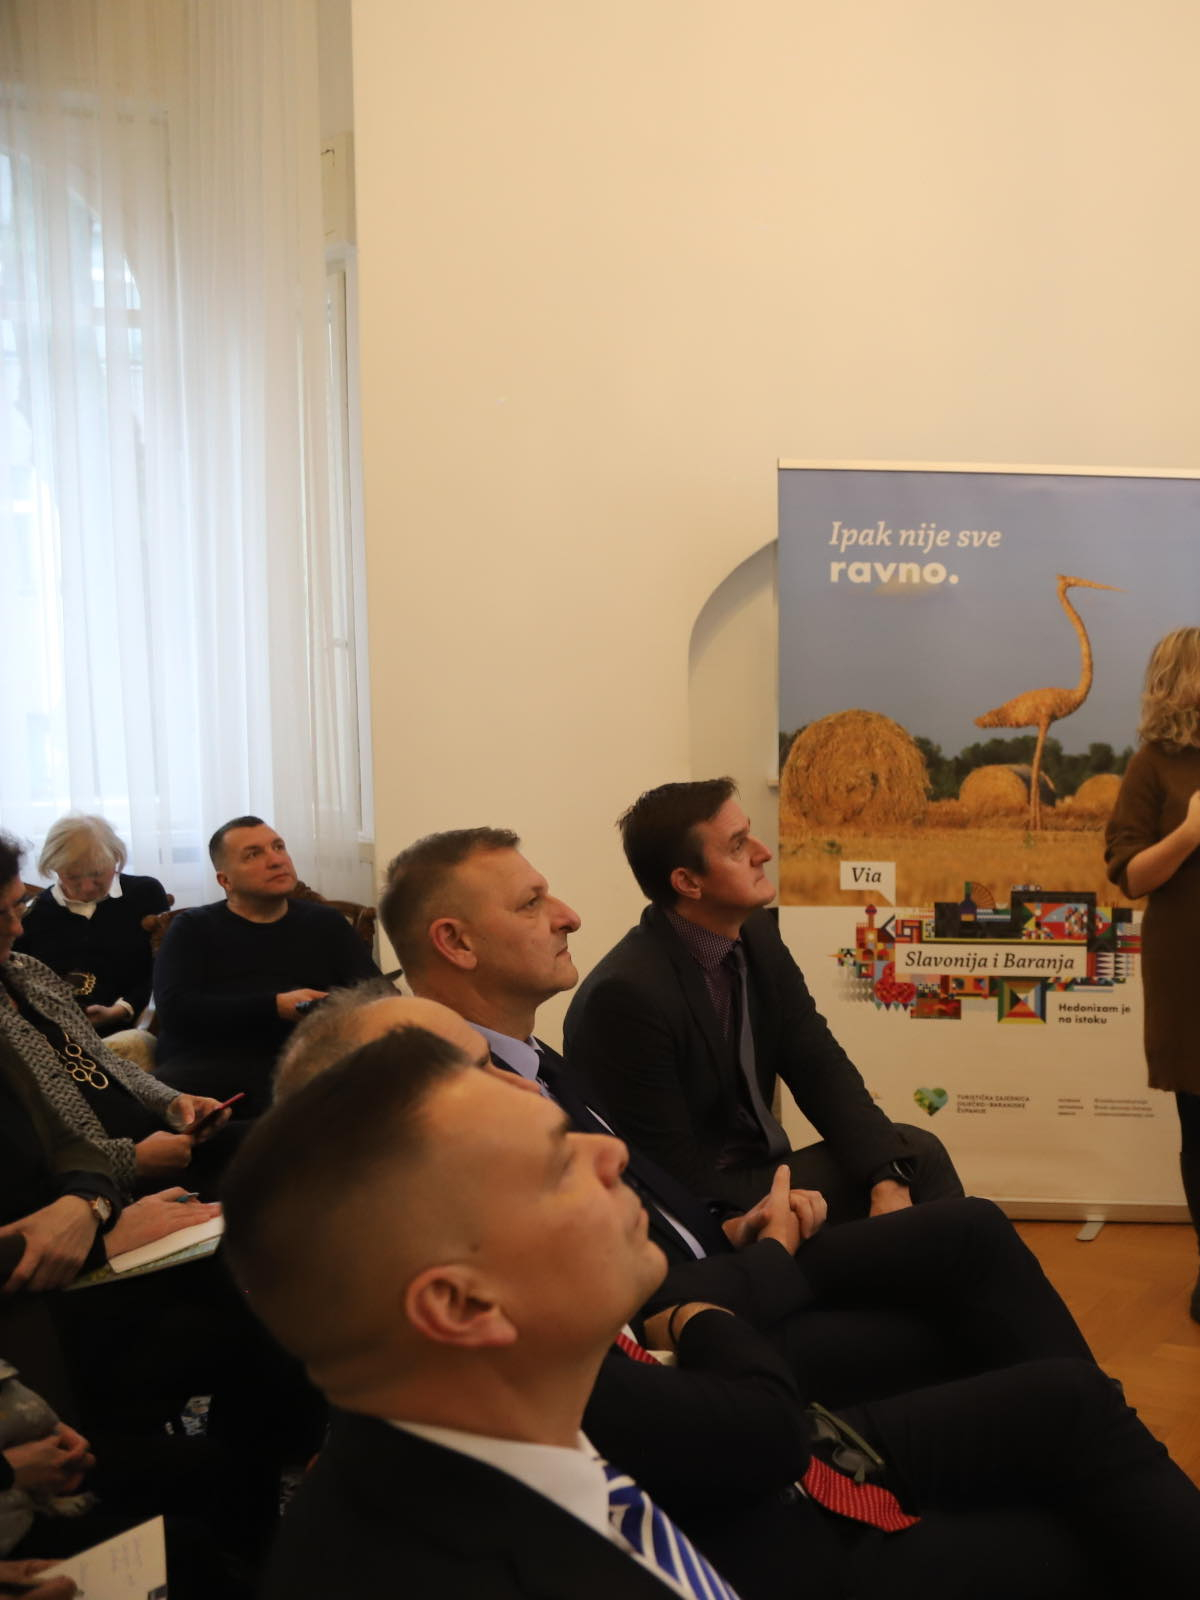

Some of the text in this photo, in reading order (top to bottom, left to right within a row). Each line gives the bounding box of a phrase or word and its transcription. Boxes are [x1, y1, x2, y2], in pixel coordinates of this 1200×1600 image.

[829, 521, 1003, 554] Ipak nije sve
[830, 561, 960, 585] ravno.
[851, 867, 882, 883] Via
[905, 951, 1075, 973] Slavonija i Baranja
[1058, 1003, 1131, 1015] Hedonizam je
[1058, 1014, 1108, 1025] na istoku
